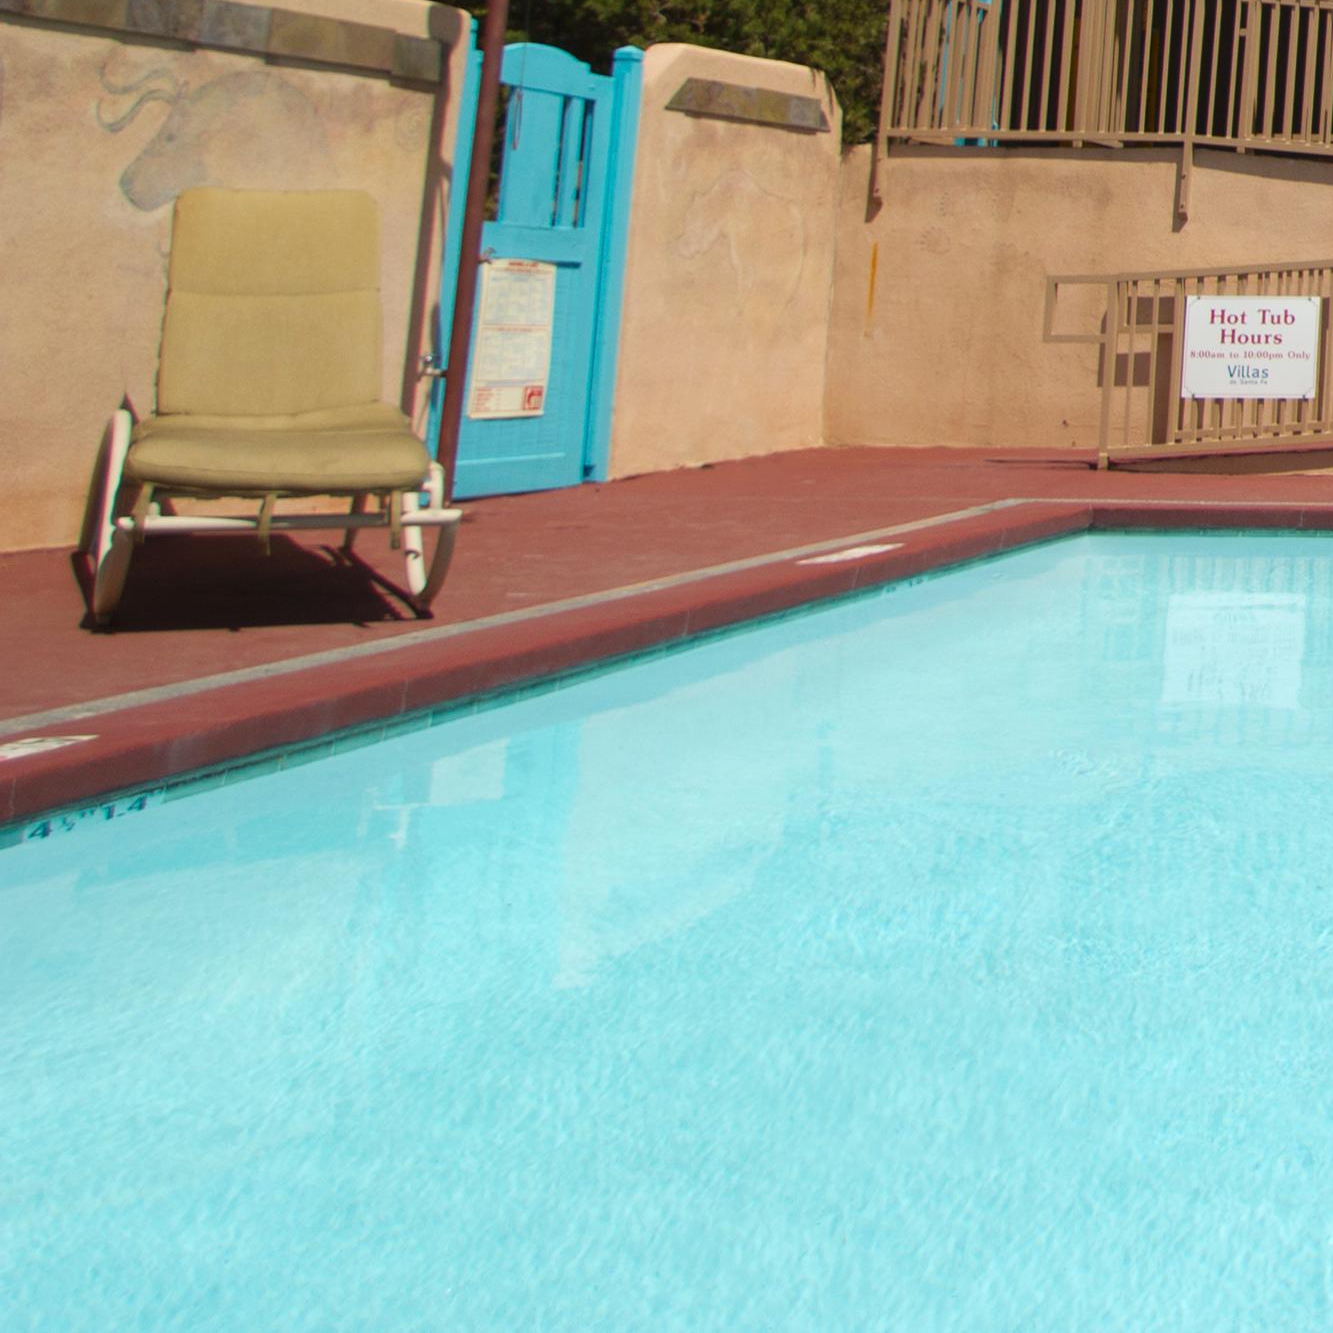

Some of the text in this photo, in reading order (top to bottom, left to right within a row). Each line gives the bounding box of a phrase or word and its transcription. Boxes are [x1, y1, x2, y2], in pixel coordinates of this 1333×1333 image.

[1210, 309, 1295, 325] Hot Tub
[1220, 329, 1283, 345] Hours
[1288, 350, 1311, 360] Only
[1227, 365, 1269, 379] Villas
